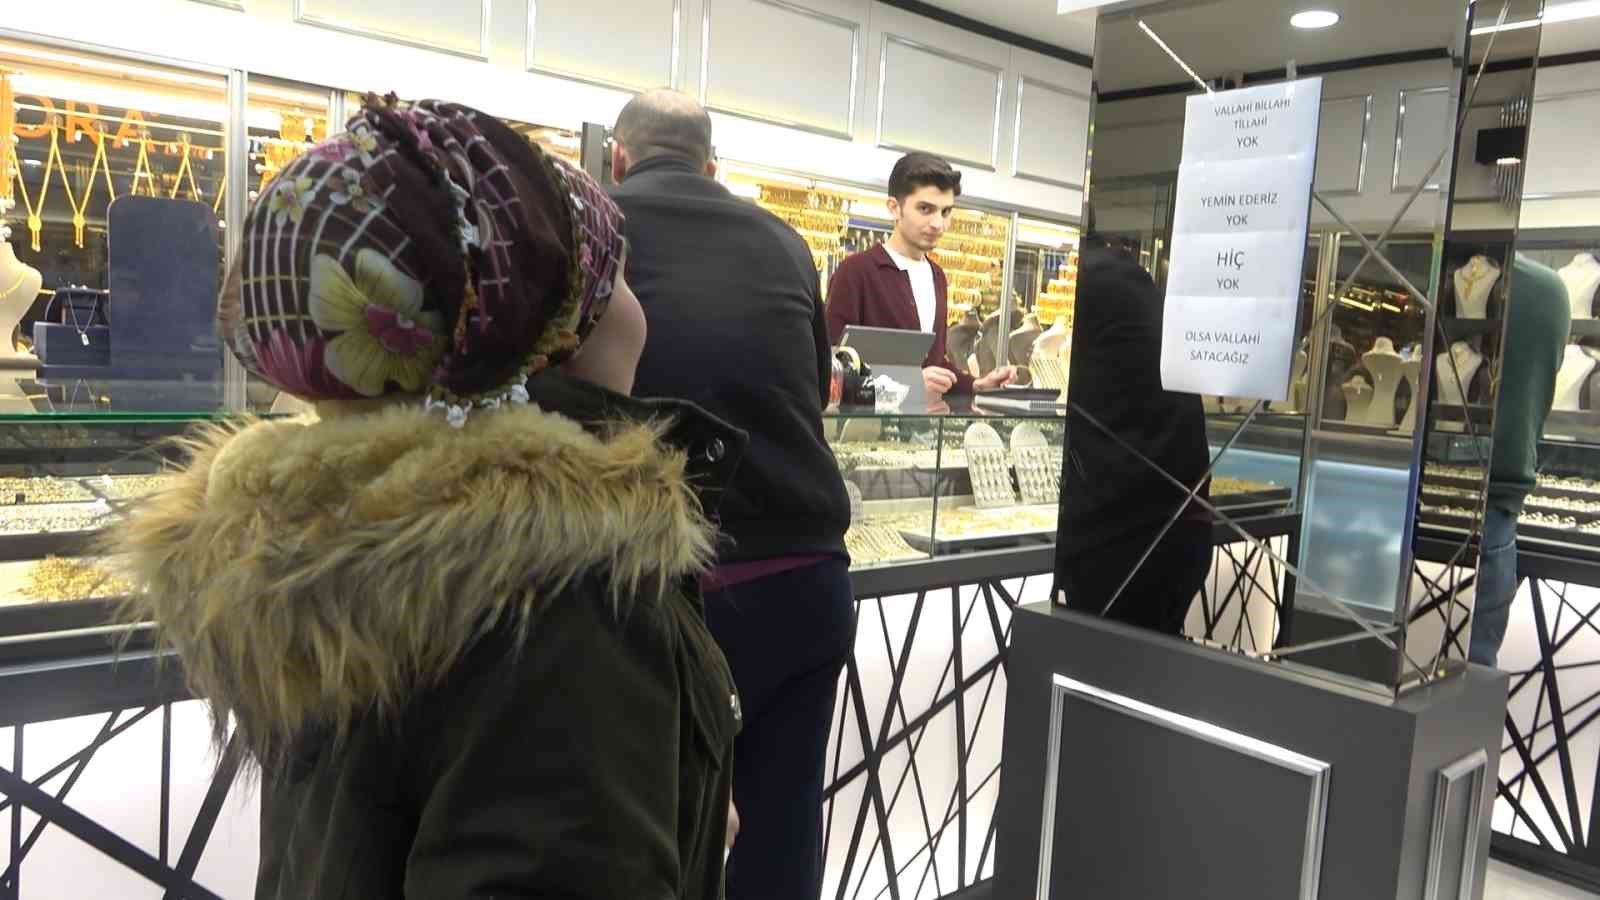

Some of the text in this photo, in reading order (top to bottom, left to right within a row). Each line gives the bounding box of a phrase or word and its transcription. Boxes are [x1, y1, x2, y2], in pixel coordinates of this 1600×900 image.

[1236, 135, 1258, 149] YOK
[1201, 191, 1278, 208] YEMİN EDERİZ
[1226, 214, 1249, 227] YOK
[1217, 248, 1245, 271] HİÇ
[1216, 278, 1240, 291] YOK
[1185, 329, 1261, 345] OLSA VALLAHİ
[1190, 349, 1249, 365] SATACAĞIZ
